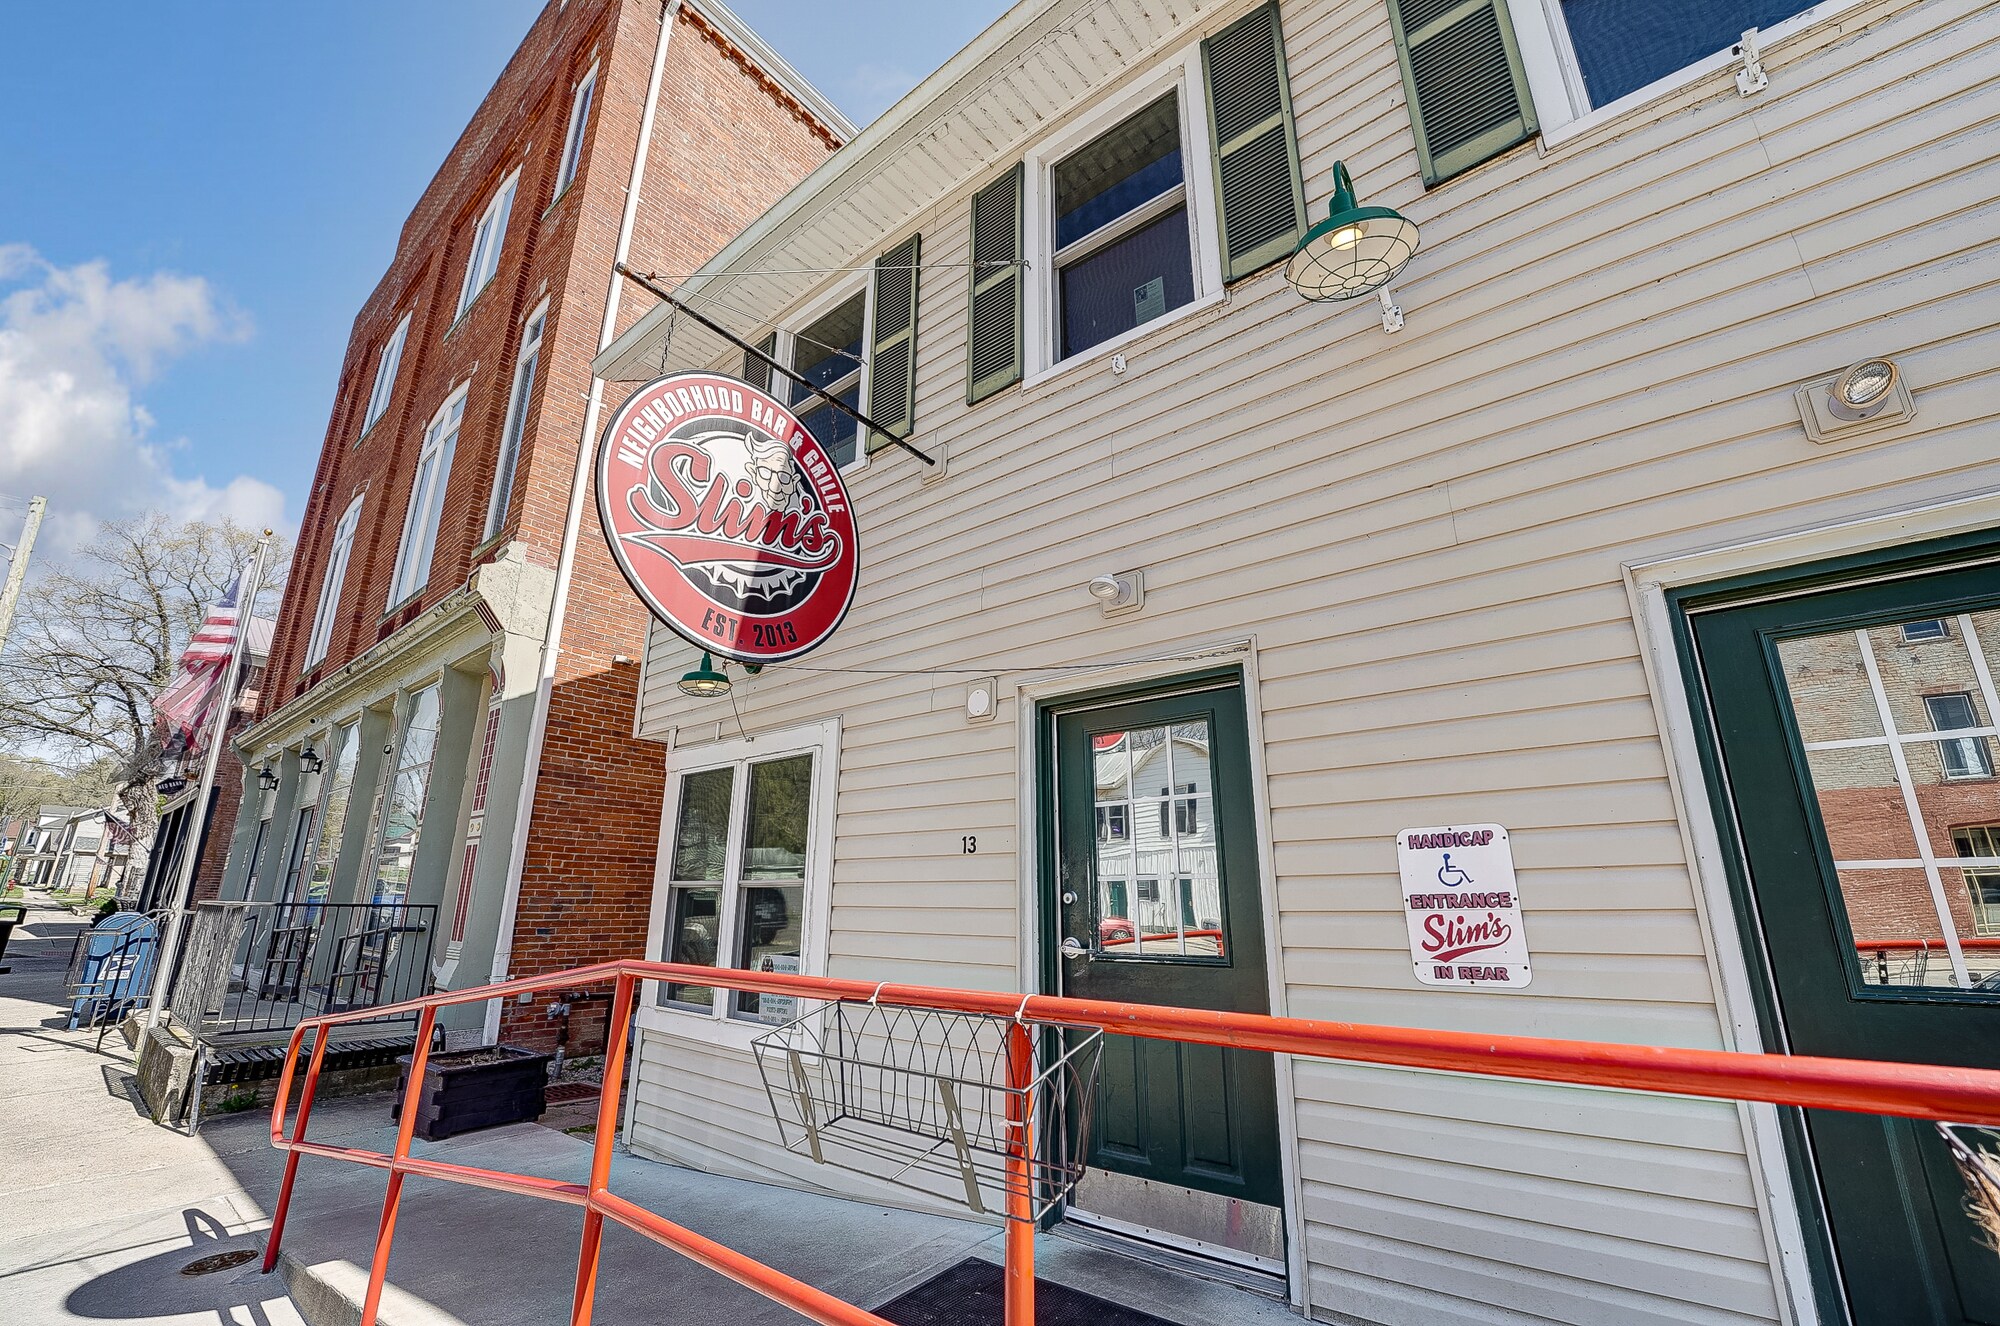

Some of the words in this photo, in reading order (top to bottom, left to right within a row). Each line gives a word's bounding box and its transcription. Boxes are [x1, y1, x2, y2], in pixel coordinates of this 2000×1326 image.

[617, 386, 744, 470] NEIGHBORHOOD
[751, 399, 788, 437] BAR
[789, 431, 802, 451] &
[803, 450, 845, 514] GRILLE
[627, 442, 831, 551] Slim's
[753, 621, 797, 647] 2013
[961, 835, 977, 854] 13
[1408, 830, 1494, 850] HANDICAP
[1410, 892, 1513, 910] ENTRANCE
[1421, 912, 1510, 952] Slim's
[1433, 966, 1454, 980] IN
[1459, 966, 1510, 981] REAR
